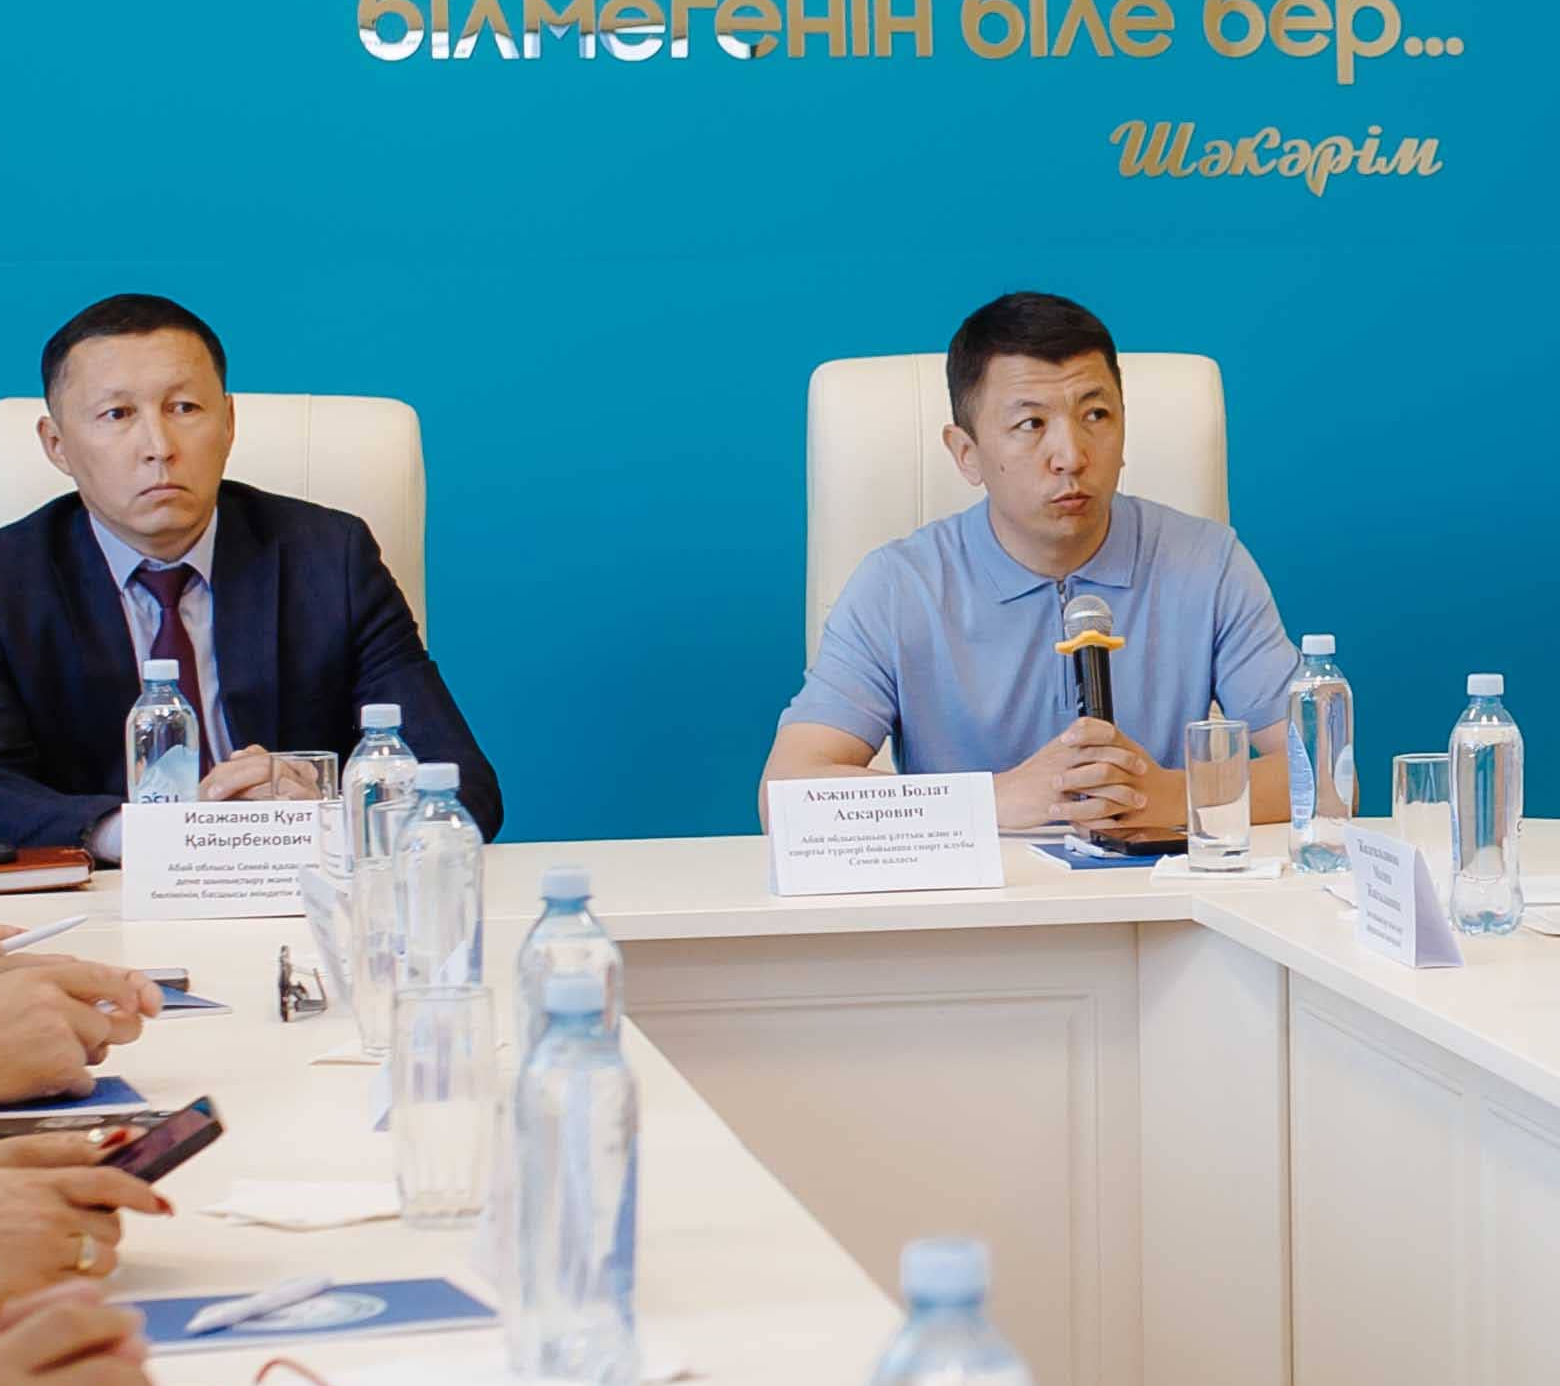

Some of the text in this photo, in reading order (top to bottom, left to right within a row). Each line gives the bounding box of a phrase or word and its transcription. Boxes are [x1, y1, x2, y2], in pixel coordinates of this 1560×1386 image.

[1110, 119, 1443, 198] Шәкәрім
[802, 784, 950, 802] Акжигитов Болат
[184, 810, 313, 825] Исажанов Қуат
[833, 807, 924, 823] Аскарович
[185, 832, 312, 849] Қайырбекович
